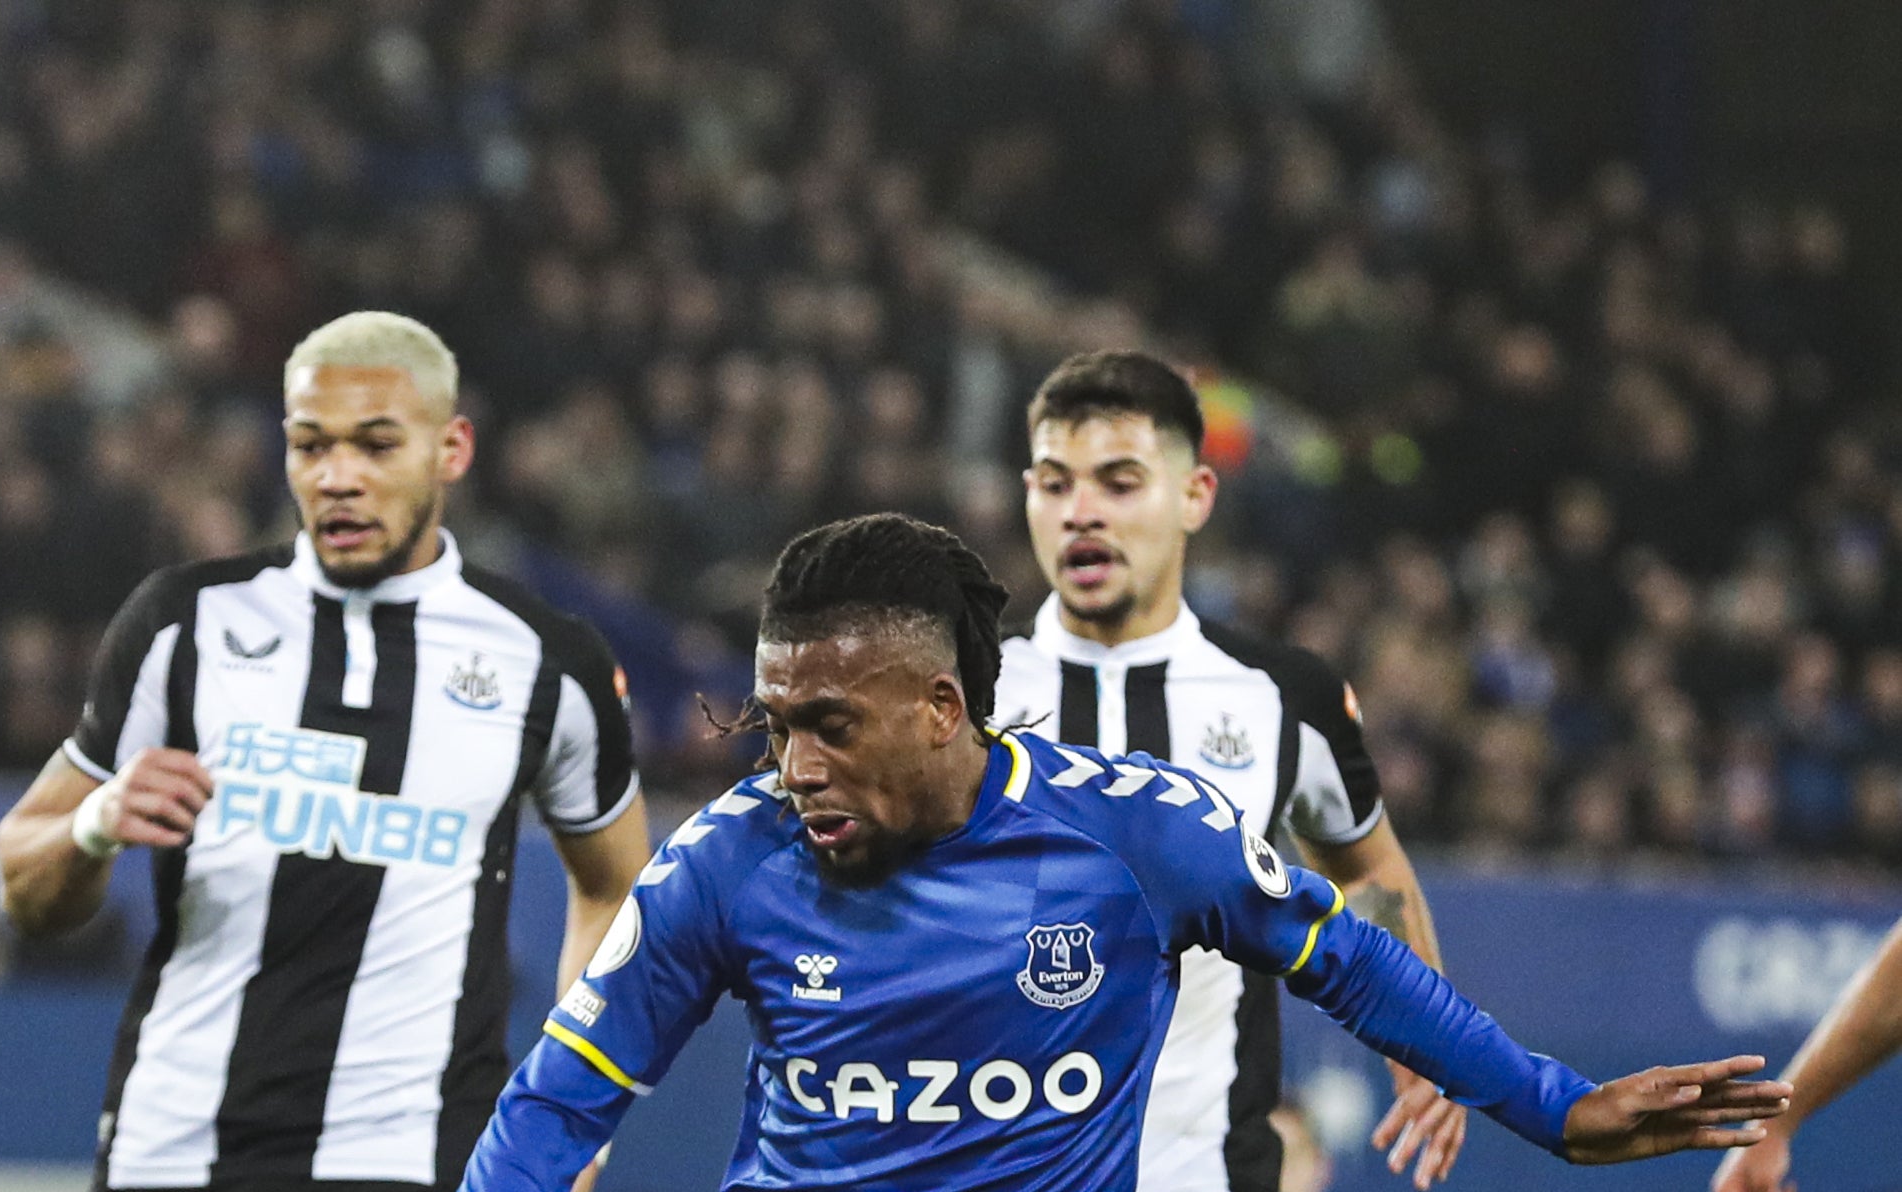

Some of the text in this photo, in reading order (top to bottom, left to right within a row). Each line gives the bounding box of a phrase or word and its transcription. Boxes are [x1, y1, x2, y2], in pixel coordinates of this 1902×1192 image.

[217, 783, 468, 867] FUN88
[792, 983, 842, 1002] hummel
[1038, 970, 1084, 984] Everton
[786, 1051, 1102, 1123] CAZOO
